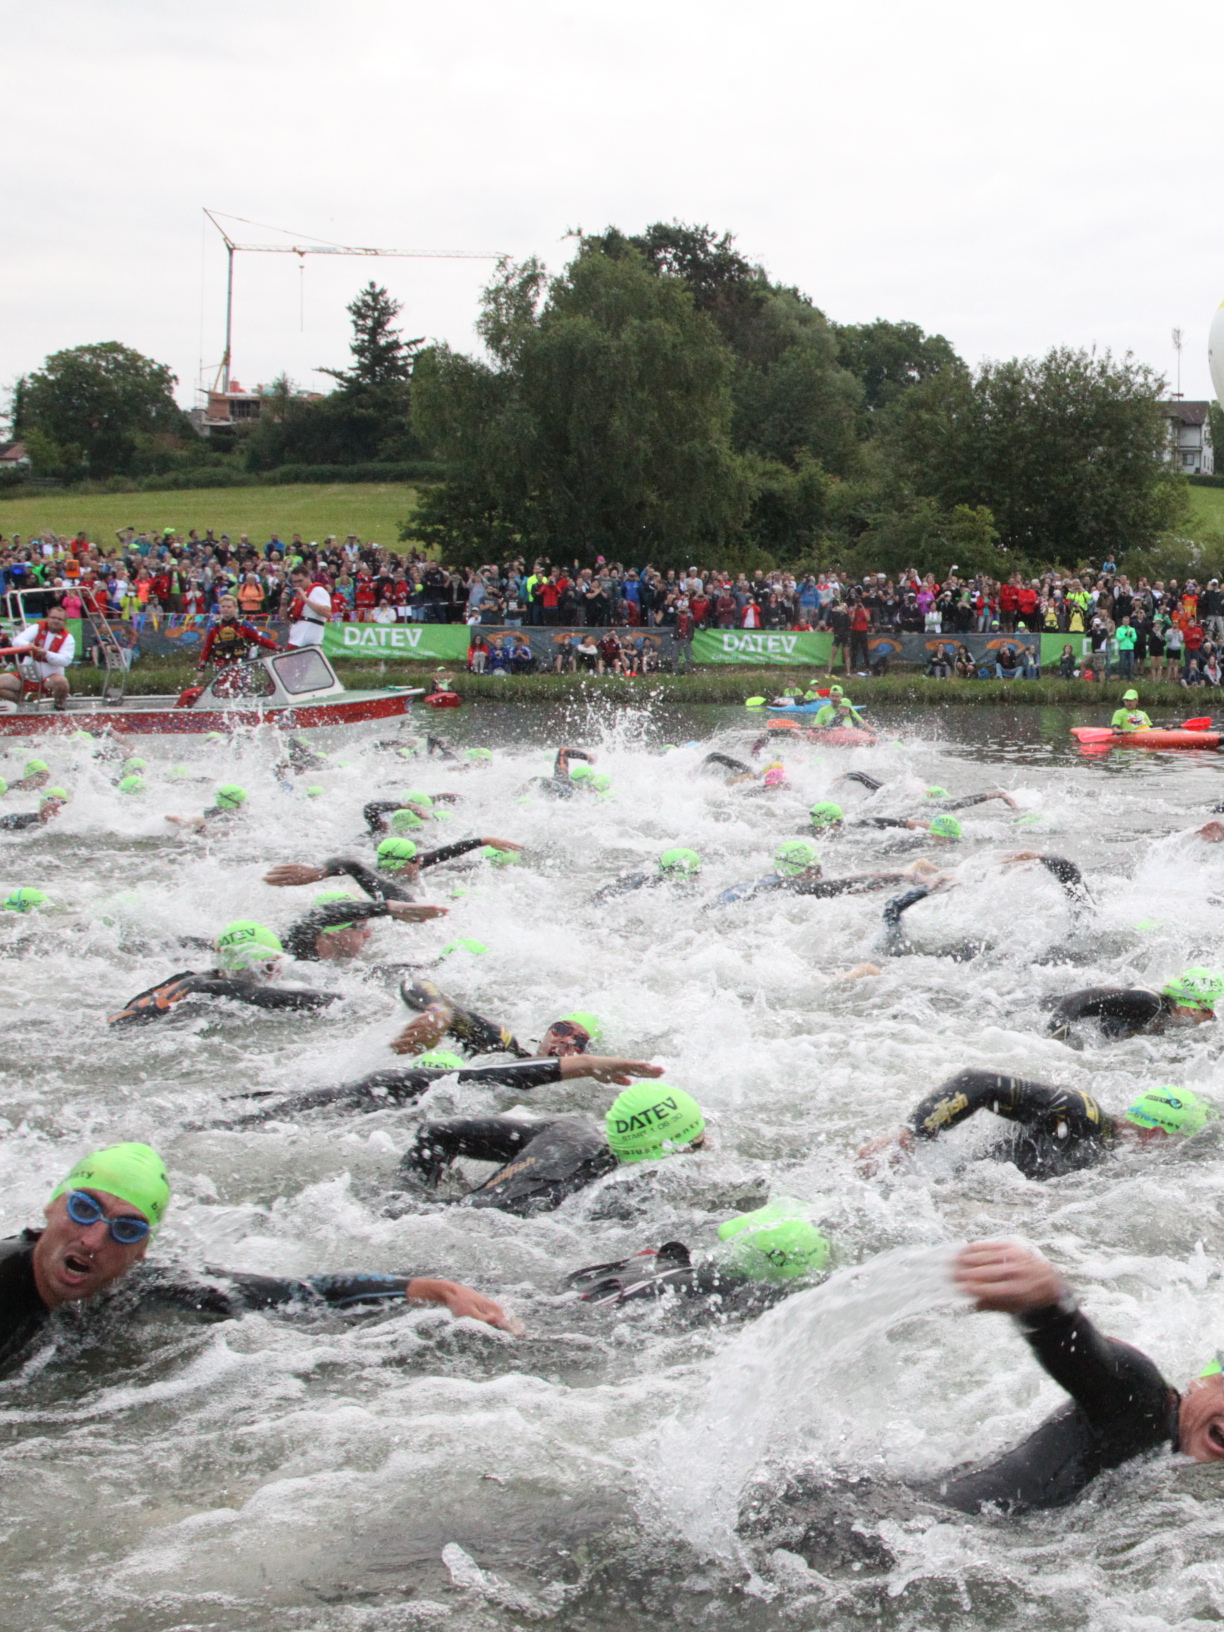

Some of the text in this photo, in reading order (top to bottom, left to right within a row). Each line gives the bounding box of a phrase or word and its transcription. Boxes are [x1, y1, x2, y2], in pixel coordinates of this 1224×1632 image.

[344, 626, 423, 647] DATEV
[723, 633, 798, 654] DATEV
[616, 1096, 678, 1134] DATEV
